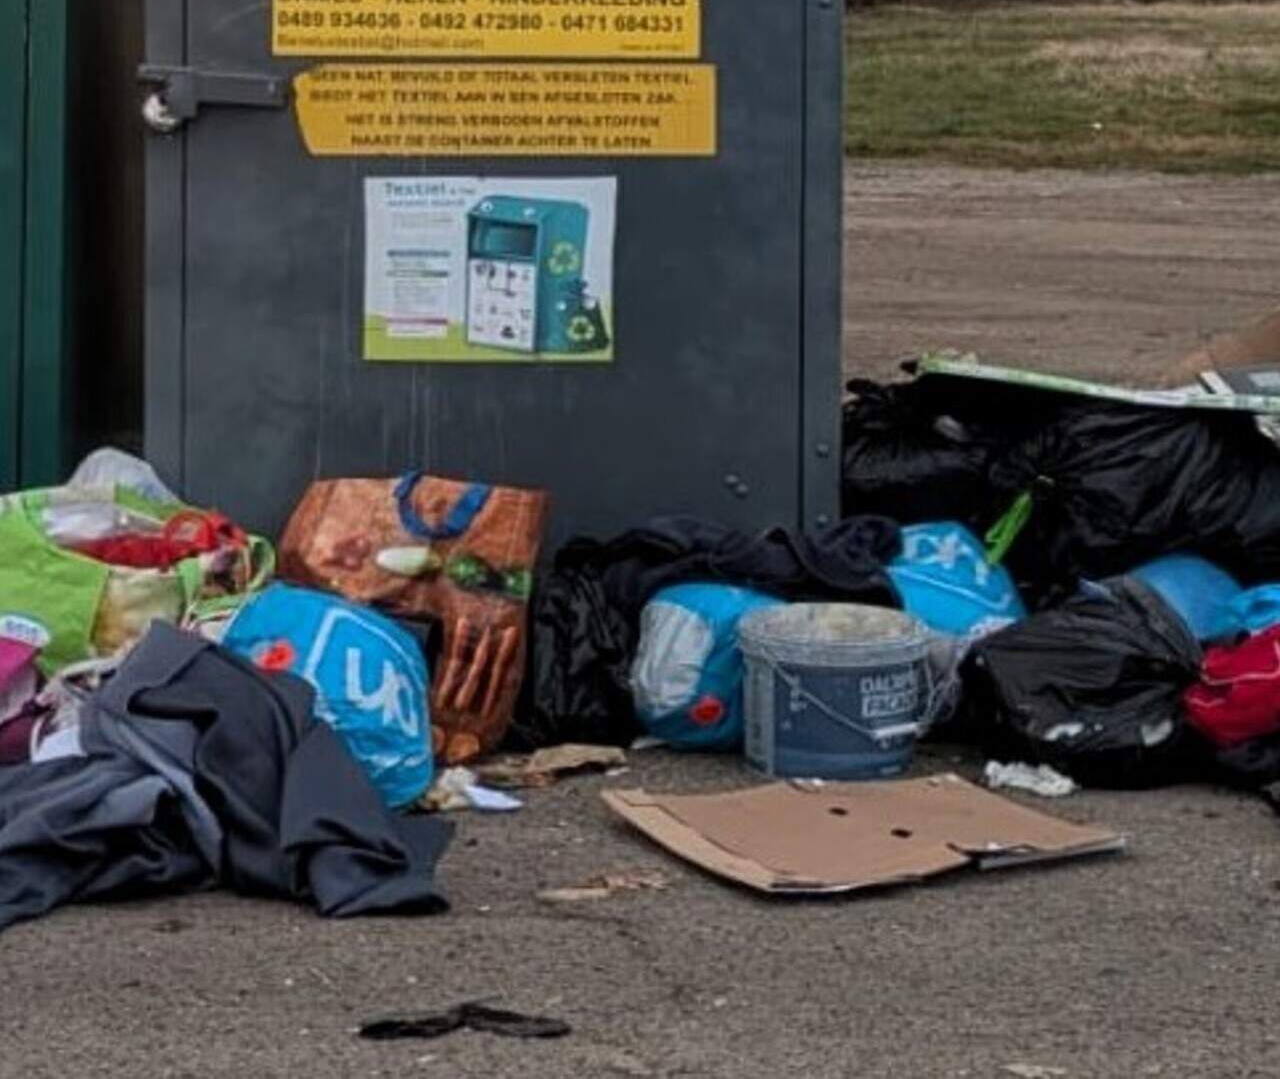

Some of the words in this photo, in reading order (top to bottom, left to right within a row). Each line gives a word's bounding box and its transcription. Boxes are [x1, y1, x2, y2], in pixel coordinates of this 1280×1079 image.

[276, 11, 324, 28] 0489
[419, 13, 467, 30] 0492
[472, 14, 543, 31] 472980
[560, 15, 607, 32] 0471
